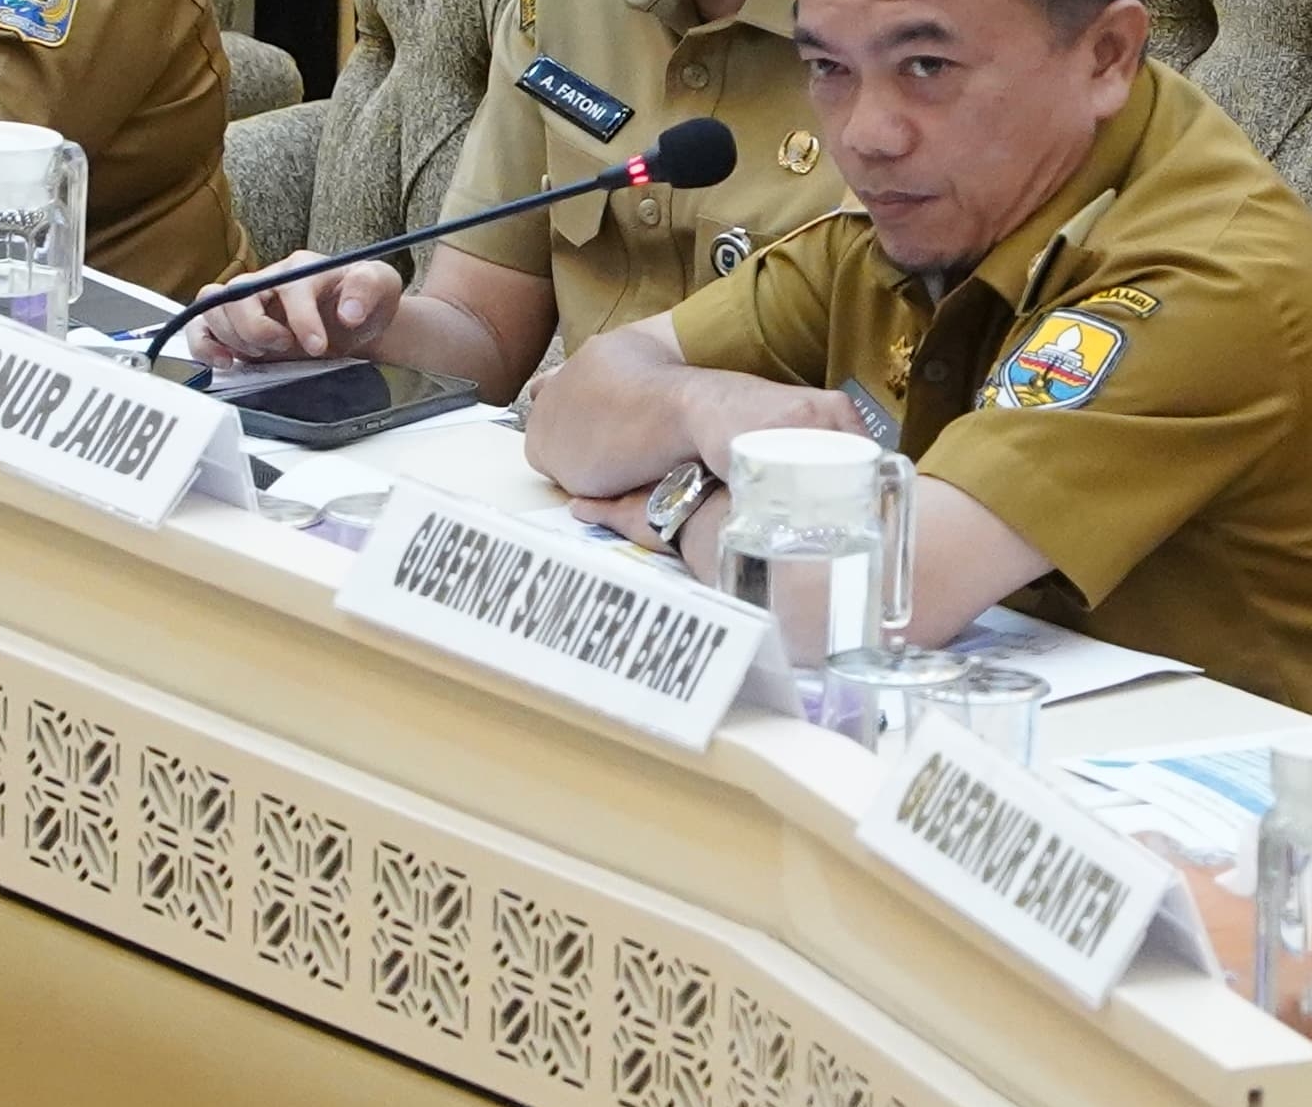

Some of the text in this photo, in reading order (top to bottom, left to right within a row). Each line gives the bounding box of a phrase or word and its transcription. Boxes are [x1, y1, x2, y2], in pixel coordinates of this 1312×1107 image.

[539, 75, 607, 121] A. FATONI
[50, 386, 179, 482] JAMBI
[393, 511, 729, 703] GUBERNUR SUMATERA BARAT
[896, 751, 1132, 959] GUBERNUR BANTEN
